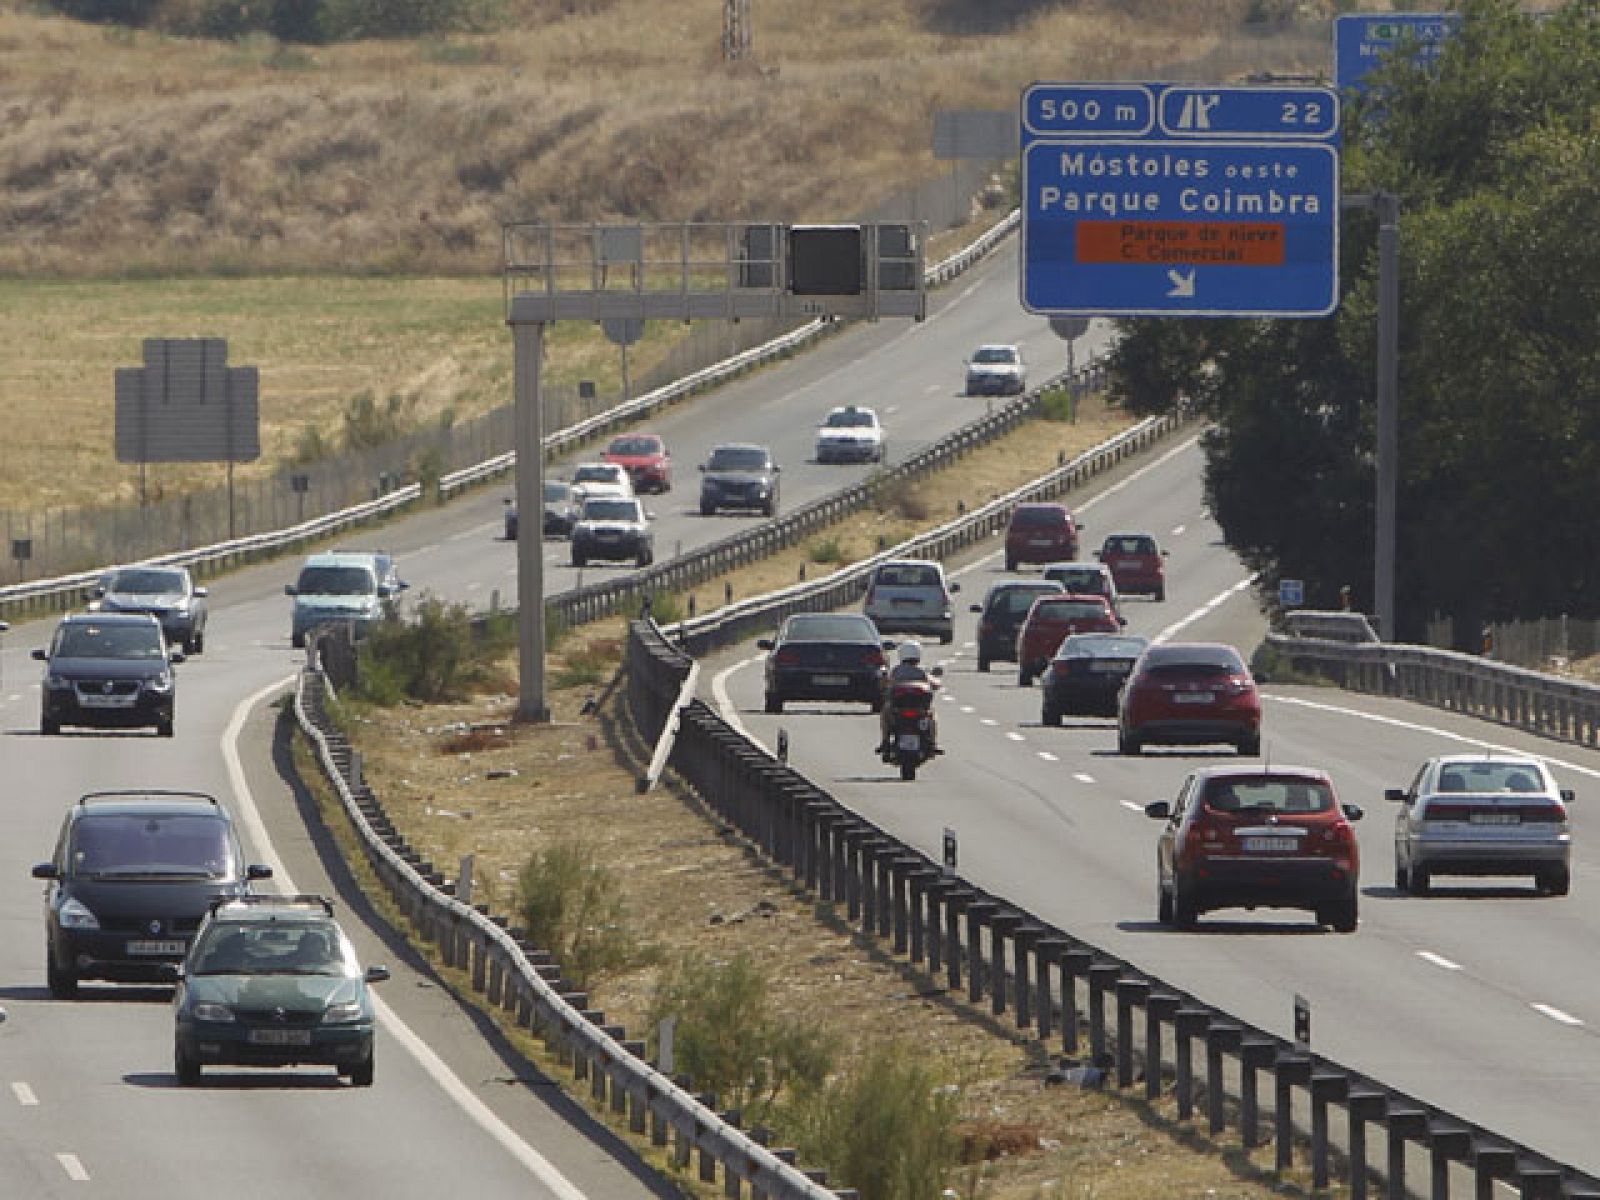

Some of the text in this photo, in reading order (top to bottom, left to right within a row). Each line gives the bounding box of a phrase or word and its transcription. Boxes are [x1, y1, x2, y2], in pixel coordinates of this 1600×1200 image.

[1040, 100, 1136, 121] 500 m
[1280, 102, 1321, 124] 22
[1060, 151, 1299, 178] Móstoles oeste
[1039, 186, 1320, 216] Parque Coimbra
[1120, 224, 1189, 244] Parque
[1147, 243, 1243, 261] Comercial
